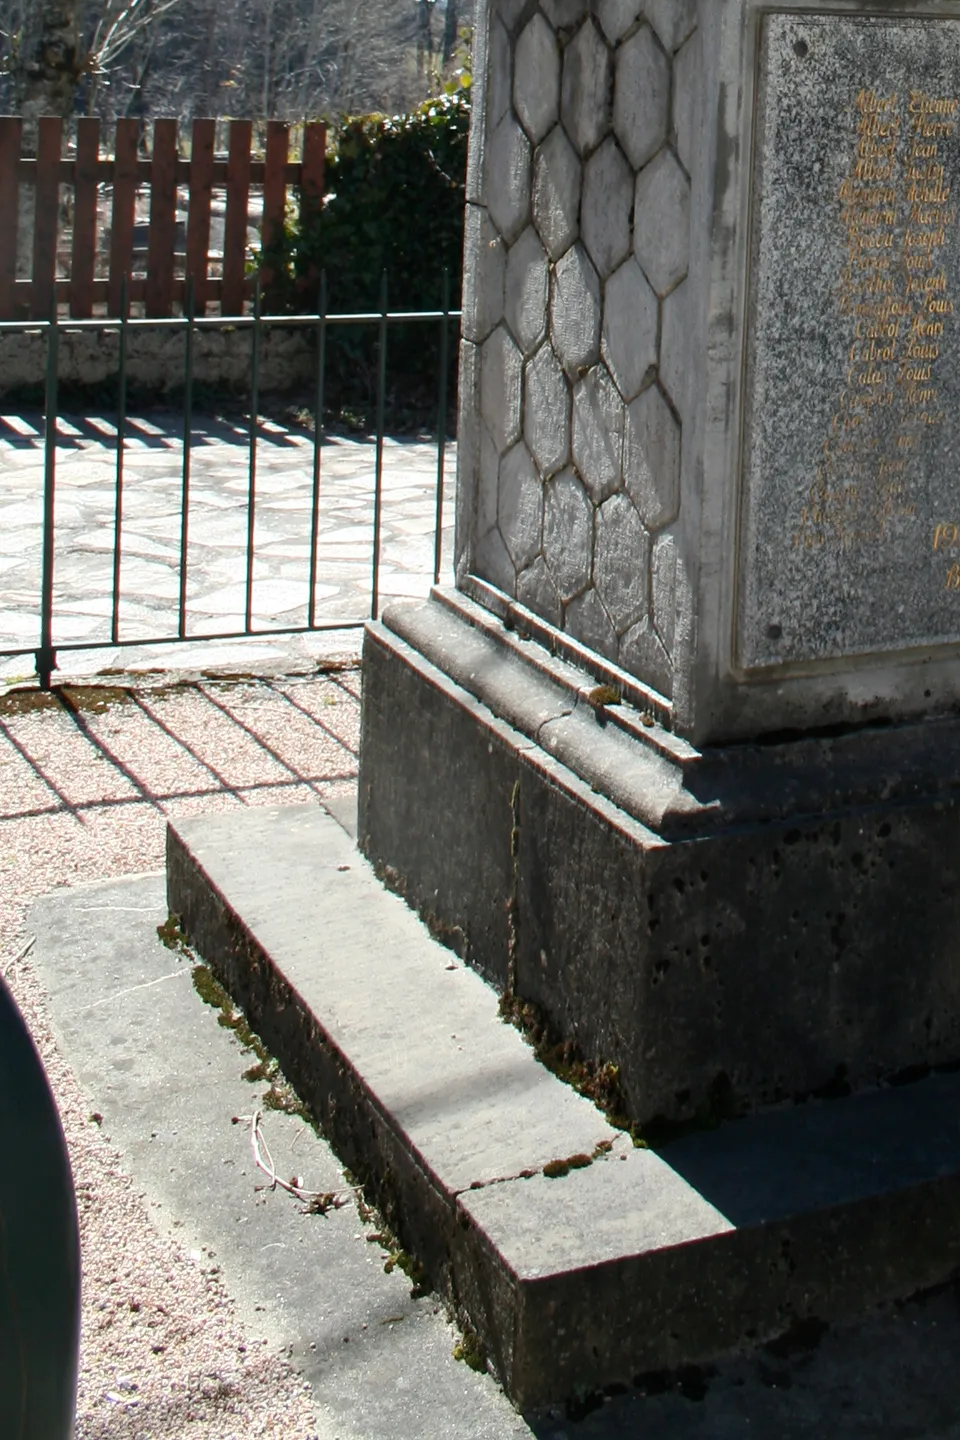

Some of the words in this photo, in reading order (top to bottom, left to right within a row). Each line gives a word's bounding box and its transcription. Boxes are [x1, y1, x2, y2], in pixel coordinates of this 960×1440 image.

[856, 88, 898, 113] Albert
[858, 114, 900, 137] Albert
[911, 112, 955, 137] Pierre
[859, 137, 897, 158] Albert
[904, 138, 938, 161] Jean
[855, 158, 896, 180] Albert
[907, 180, 950, 202] Achille
[903, 227, 945, 252] Joseph
[922, 293, 954, 313] Louis
[855, 318, 899, 338] Cabrol
[849, 338, 896, 361] Cabrol
[903, 337, 939, 360] Louis
[898, 360, 933, 382] Louis
